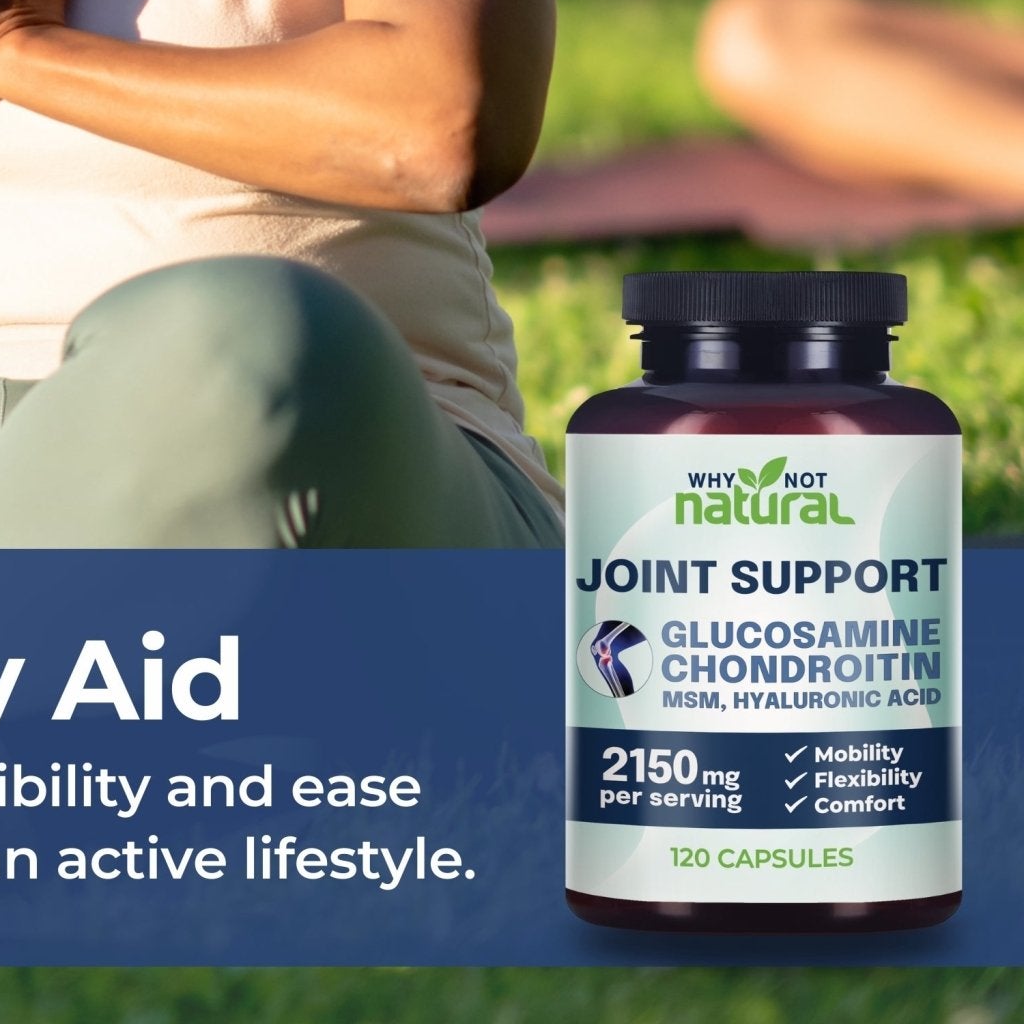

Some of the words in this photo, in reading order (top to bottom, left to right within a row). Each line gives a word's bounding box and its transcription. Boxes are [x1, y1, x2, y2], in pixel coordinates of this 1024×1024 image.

[688, 472, 736, 488] WHY
[784, 472, 827, 488] NOT
[676, 485, 856, 525] natural
[576, 558, 718, 594] JOINT
[731, 558, 948, 595] SUPPORT
[661, 618, 941, 649] GLUCOSAMINE
[661, 652, 941, 683] CHONDROITIN
[662, 691, 727, 712] MSM,
[733, 690, 881, 710] HYALURONIC
[888, 688, 941, 707] ACID
[814, 743, 904, 765] Mobility
[602, 746, 699, 786] 2150
[702, 770, 741, 791] mg
[814, 767, 923, 789] Flexibility
[600, 788, 643, 809] per
[649, 788, 743, 814] serving
[814, 794, 906, 814] Comfort
[670, 847, 711, 868] 120
[717, 847, 854, 868] CAPSULES
